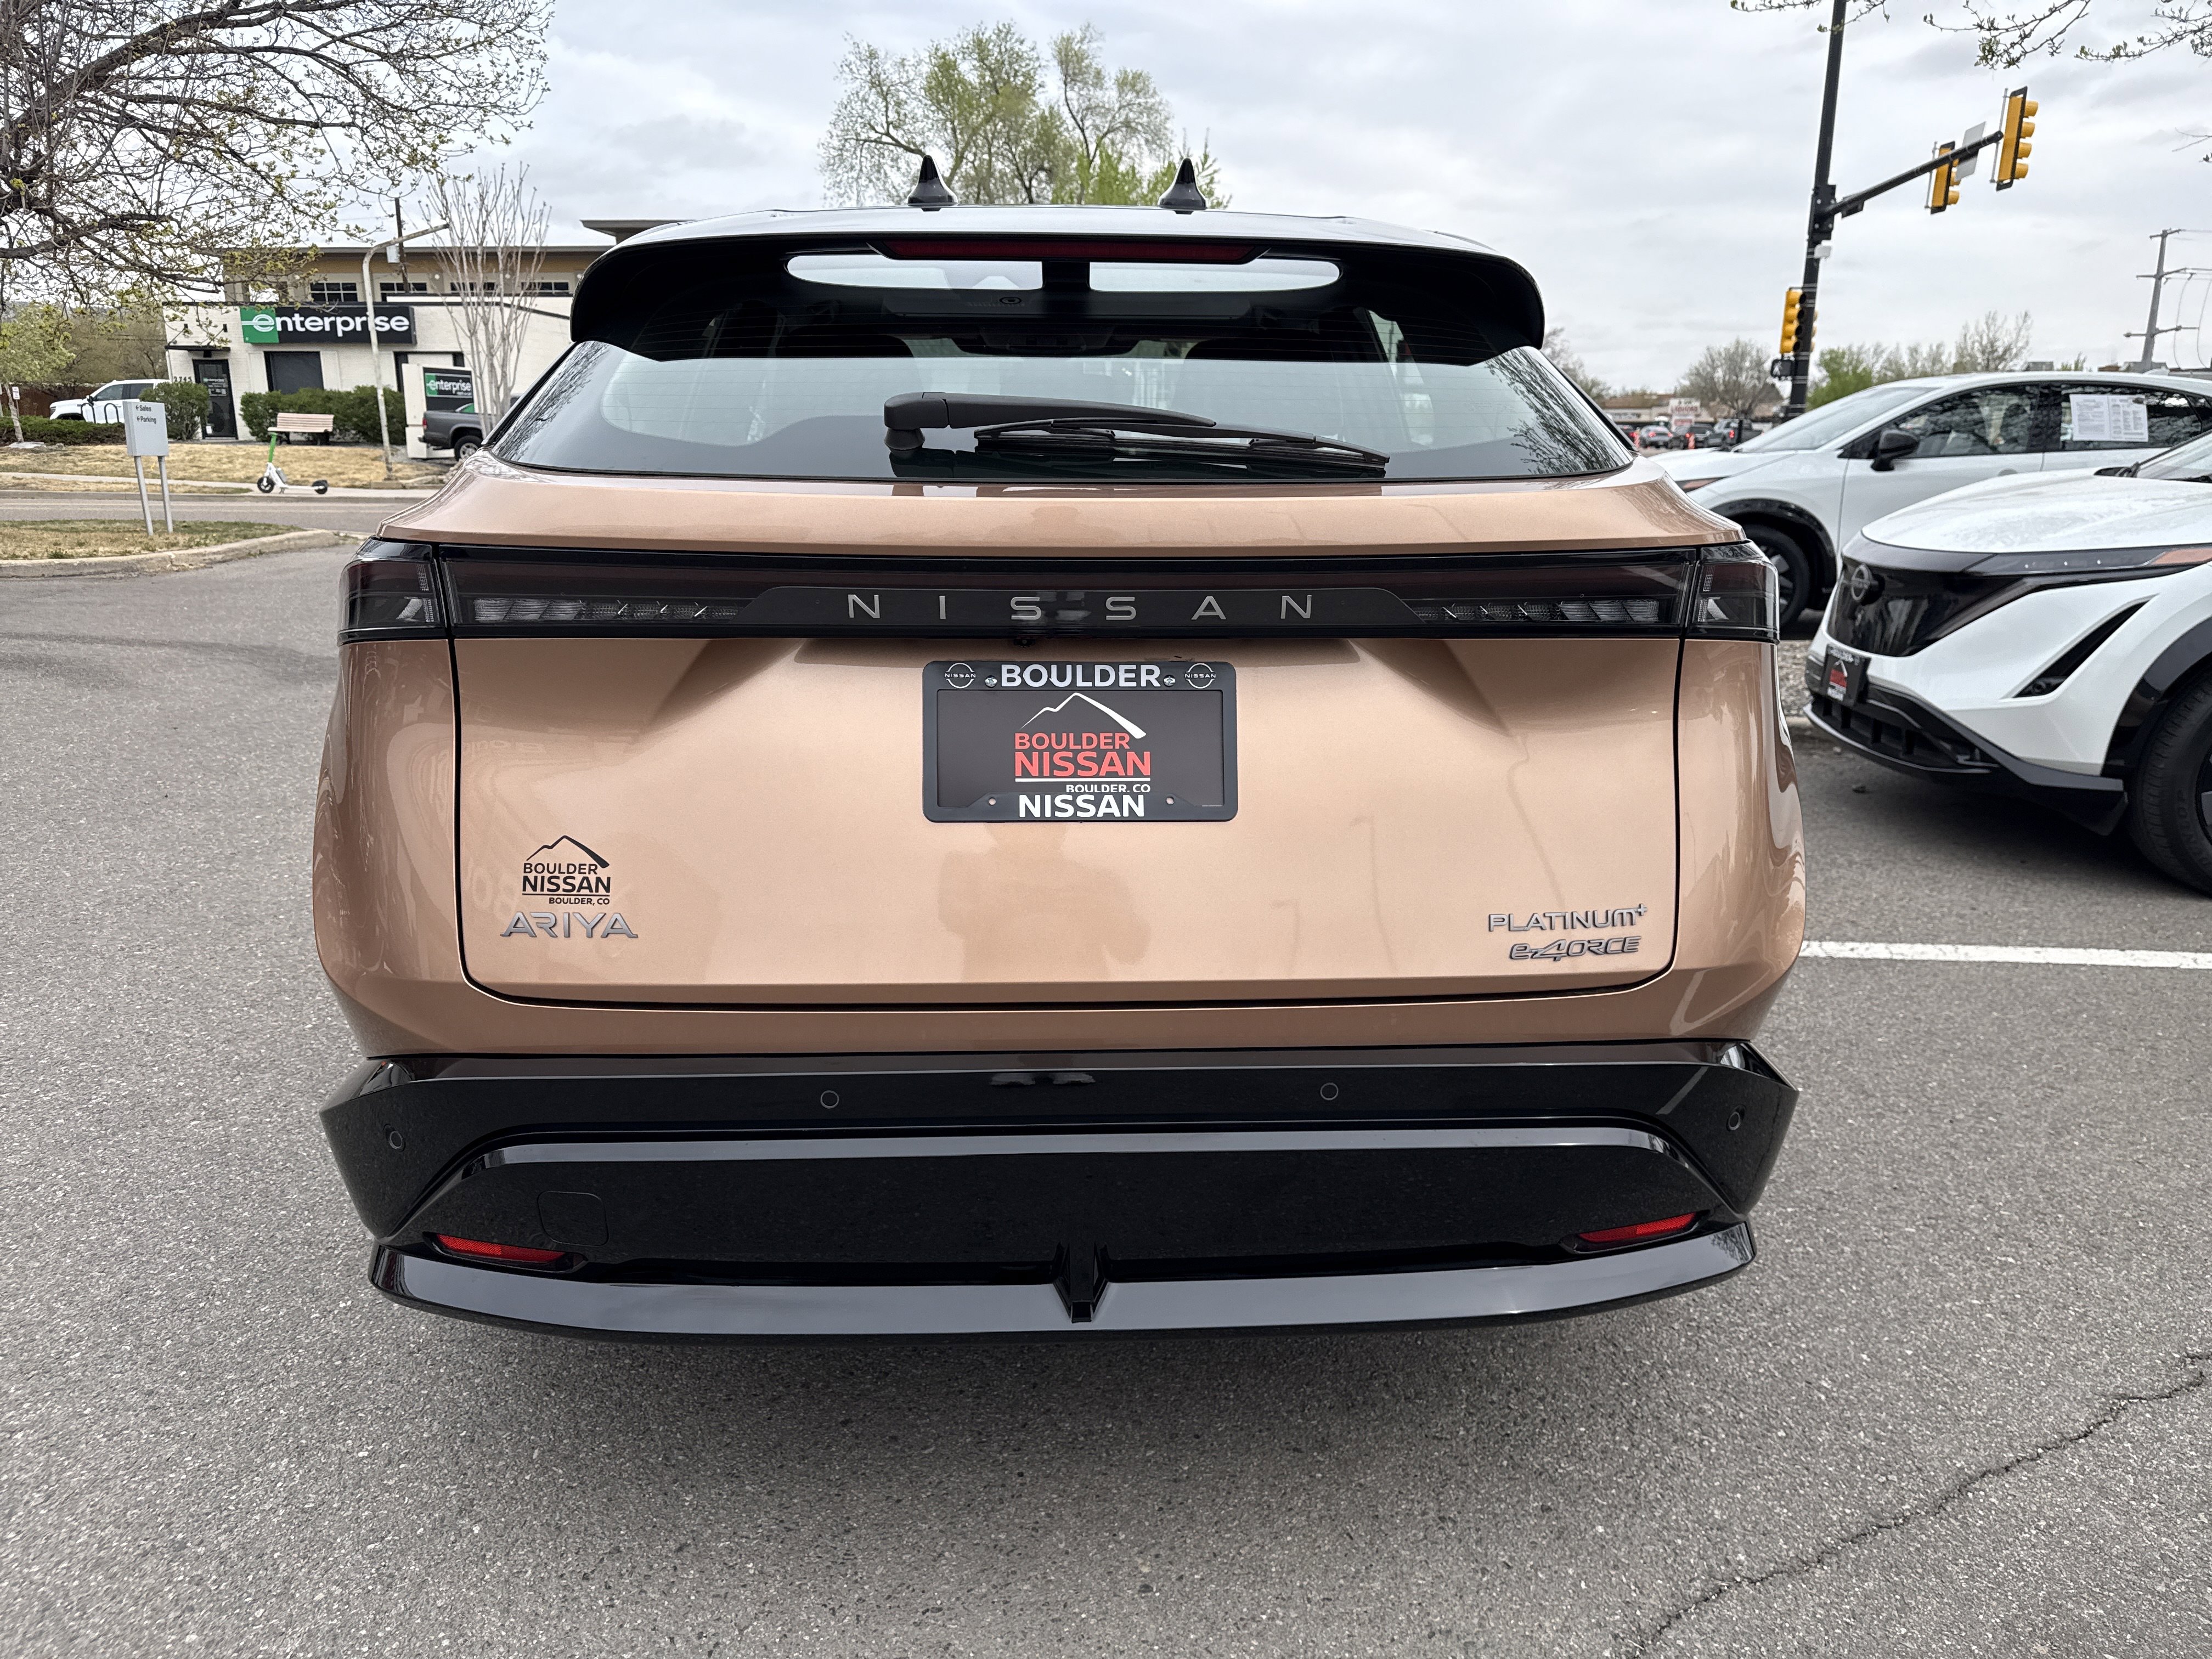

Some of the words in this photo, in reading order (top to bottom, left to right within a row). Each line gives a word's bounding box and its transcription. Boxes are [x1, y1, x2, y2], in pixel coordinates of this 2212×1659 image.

[241, 313, 410, 337] enterprse
[426, 379, 472, 394] enterprise
[140, 416, 156, 424] Parking
[848, 594, 1312, 620] NISSAN
[1001, 664, 1161, 687] BOULDER
[1015, 732, 1130, 749] BOULDER
[1015, 751, 1150, 777] NISSAN
[1132, 784, 1150, 793] CO
[1019, 794, 1144, 817] NISSAN
[523, 862, 598, 874] BOULDER
[522, 876, 611, 893] NISSAN
[549, 898, 595, 906] BOULDER,
[500, 911, 639, 939] ARIYA
